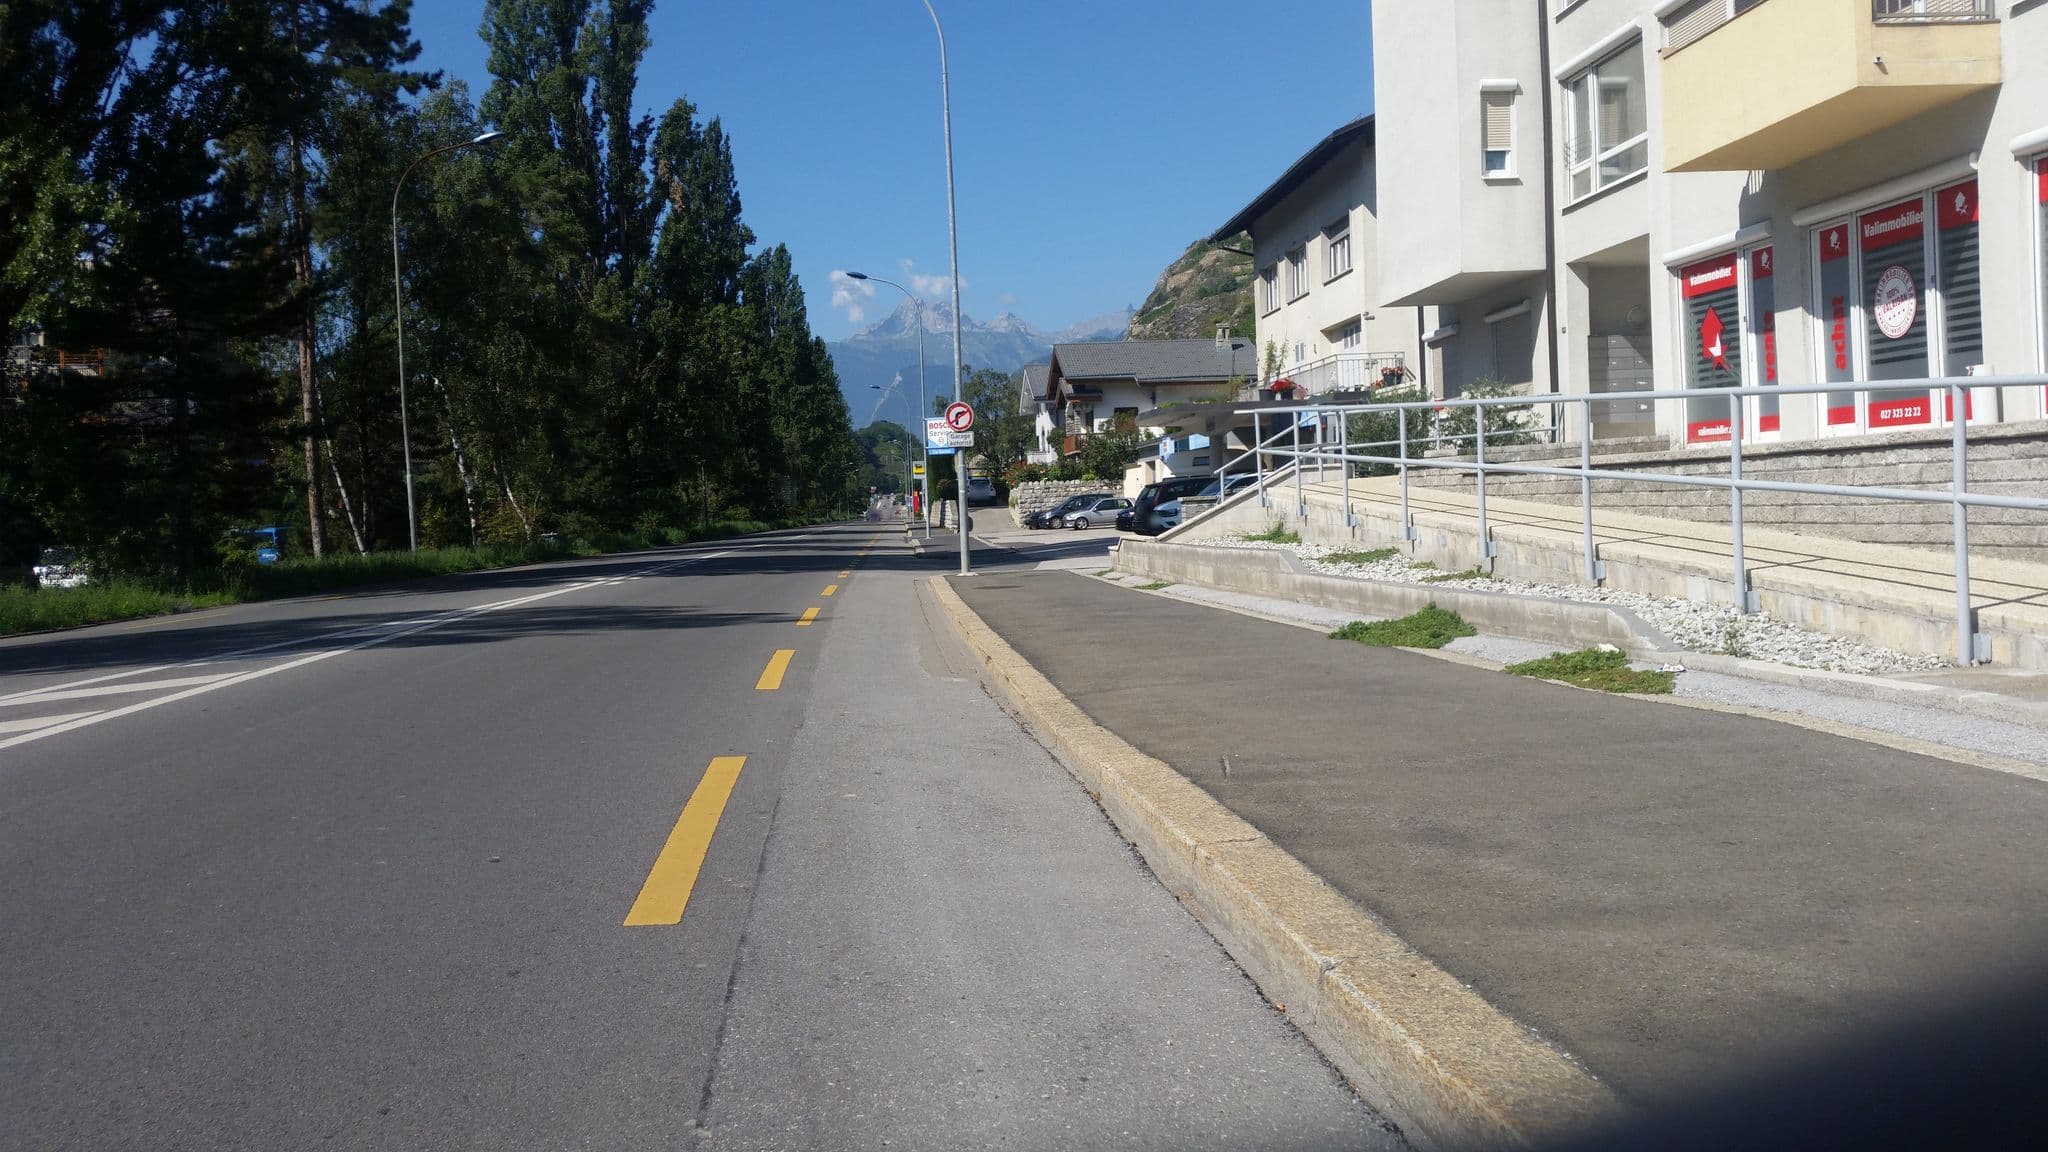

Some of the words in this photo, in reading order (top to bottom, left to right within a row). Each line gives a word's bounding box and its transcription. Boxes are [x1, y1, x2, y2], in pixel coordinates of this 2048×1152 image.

[1690, 266, 1732, 286] Valimmobilier
[1880, 409, 1891, 419] 027
[1892, 408, 1903, 418] 323
[1904, 407, 1912, 417] 22
[1913, 406, 1921, 416] 22
[928, 422, 950, 430] BOSC
